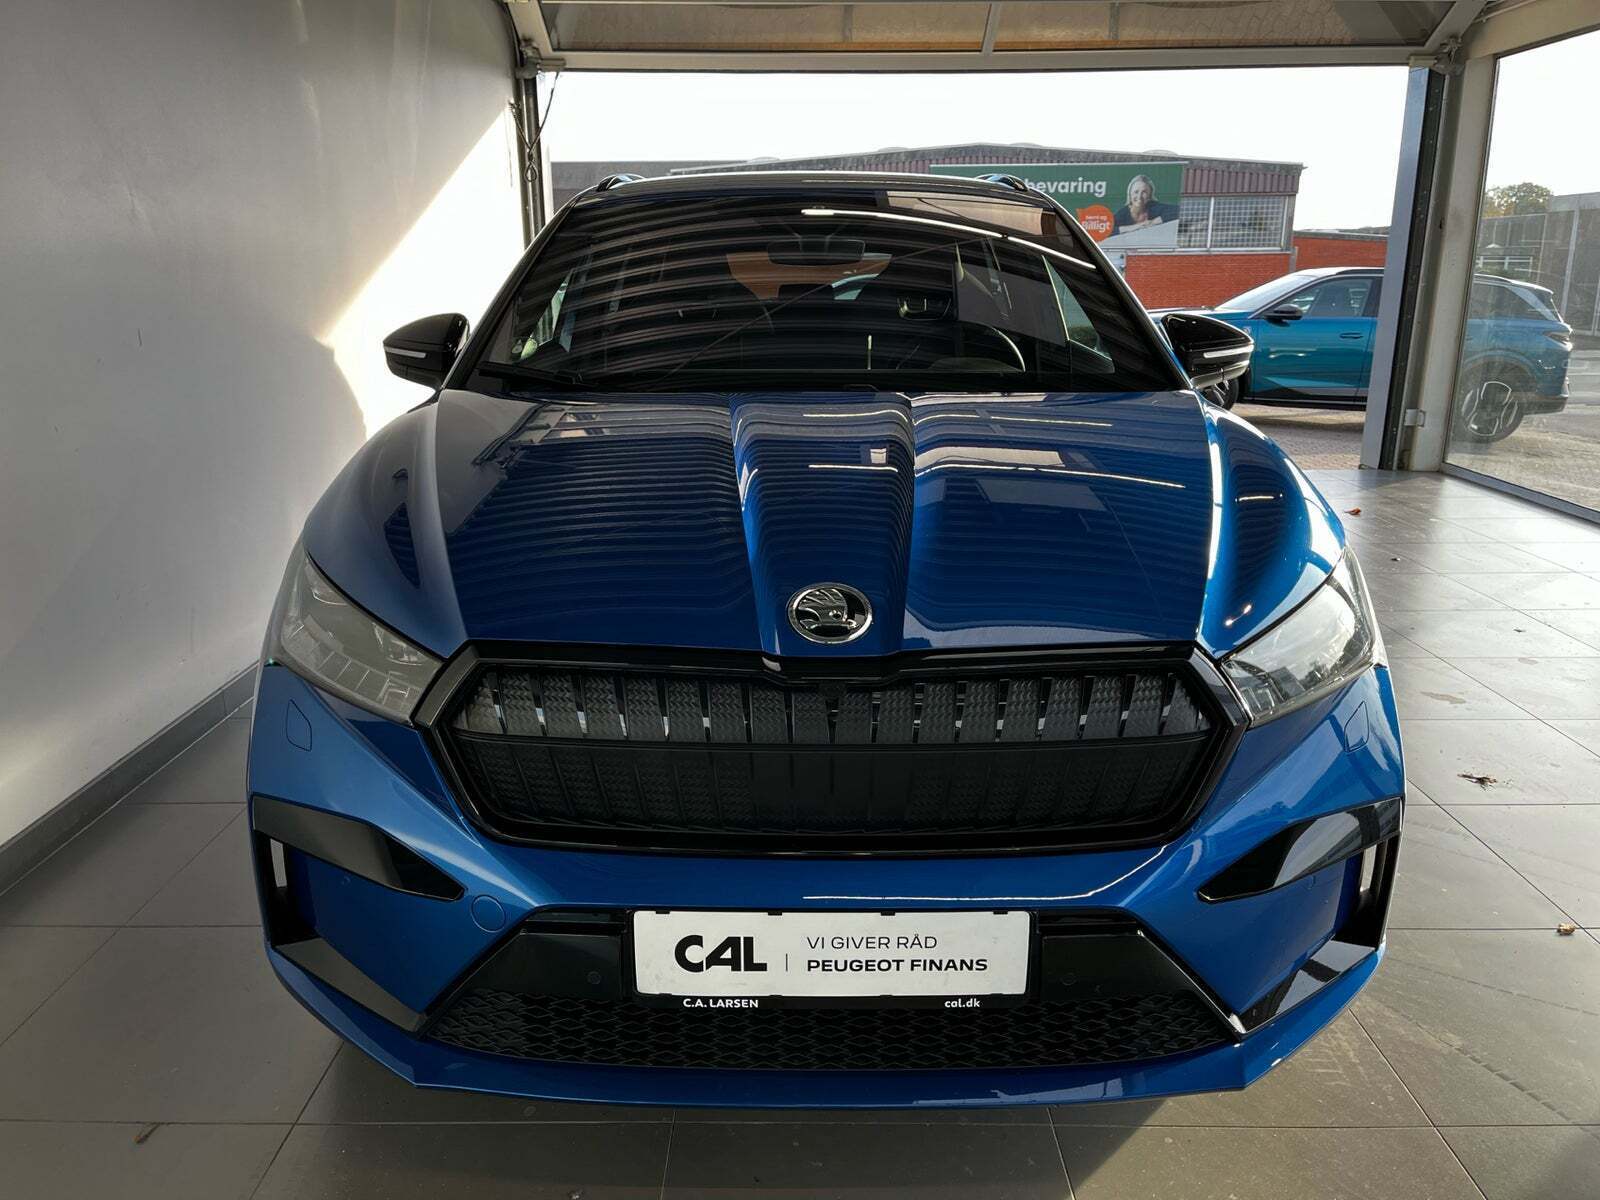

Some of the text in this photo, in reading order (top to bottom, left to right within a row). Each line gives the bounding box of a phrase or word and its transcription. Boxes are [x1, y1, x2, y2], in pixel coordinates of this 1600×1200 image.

[807, 933, 938, 950] VI GIVER RÅD
[675, 934, 768, 973] CAL
[807, 959, 988, 972] PEUGEOT FINANS
[682, 998, 759, 1009] C.A. LARSEN
[944, 998, 981, 1008] cal.dk
